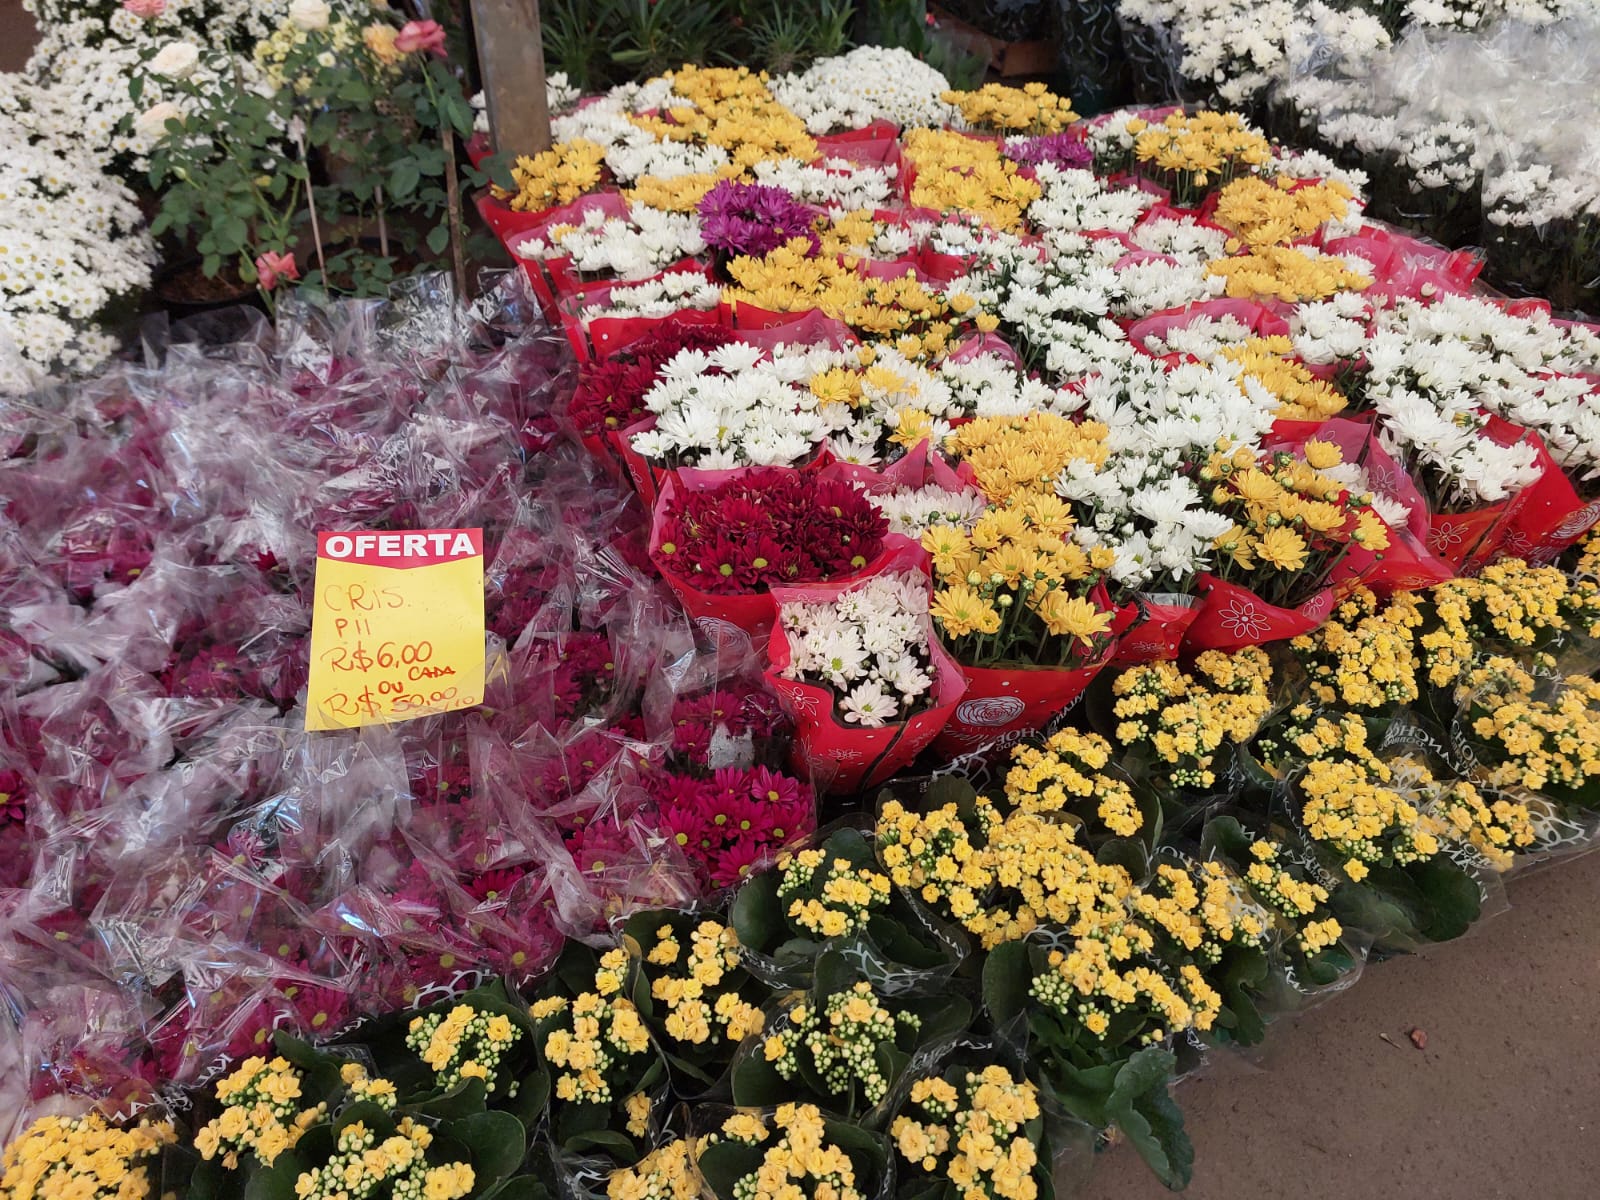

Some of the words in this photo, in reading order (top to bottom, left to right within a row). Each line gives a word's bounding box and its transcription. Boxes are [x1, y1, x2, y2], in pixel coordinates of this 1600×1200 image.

[325, 533, 476, 558] OFERTA
[408, 665, 456, 681] CADA
[378, 680, 404, 694] OU
